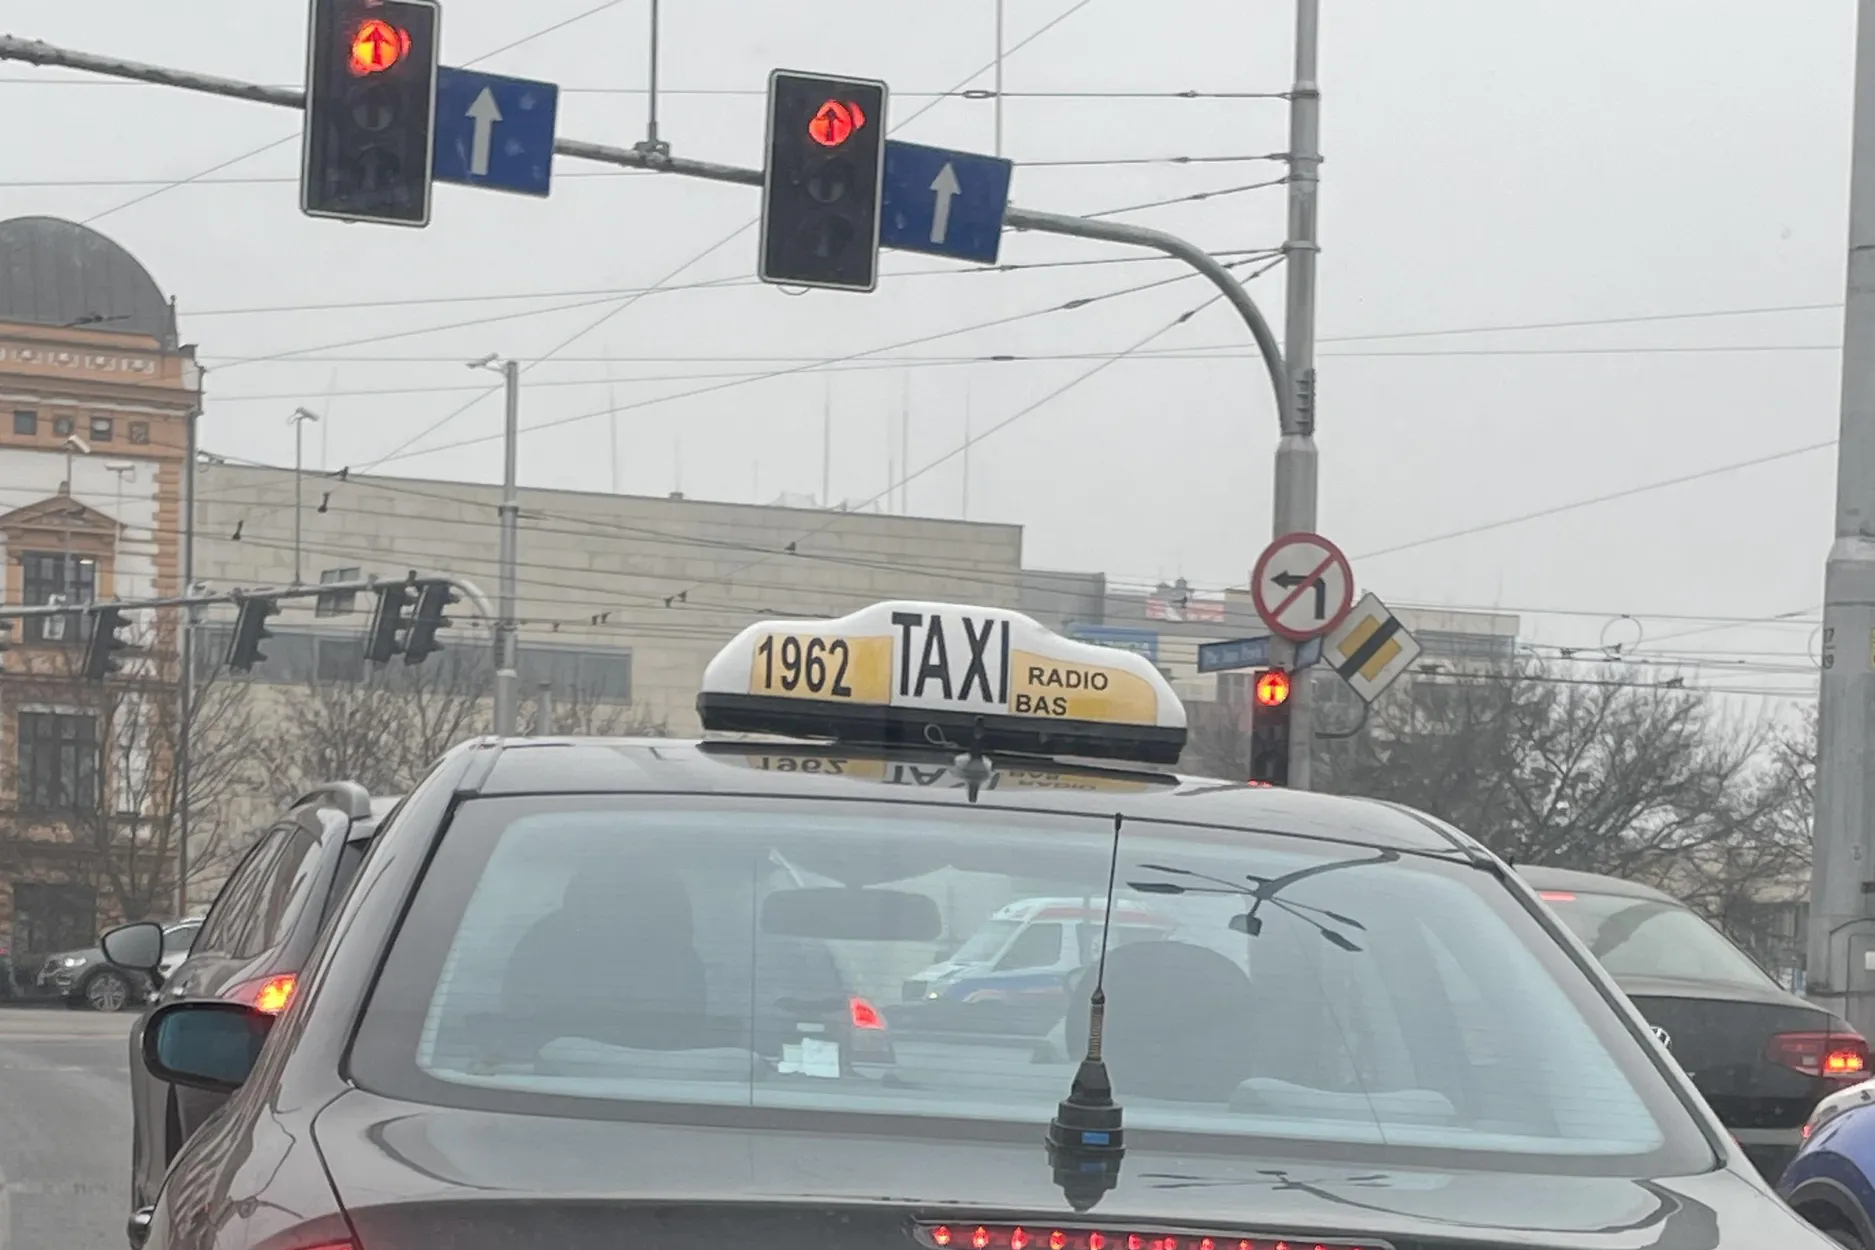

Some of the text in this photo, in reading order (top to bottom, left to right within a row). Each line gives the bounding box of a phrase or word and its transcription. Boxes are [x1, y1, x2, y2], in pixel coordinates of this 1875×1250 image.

[758, 634, 852, 698] 1962
[892, 612, 1010, 704] TAXI
[1028, 666, 1109, 692] RADIO
[1015, 694, 1068, 716] BAS
